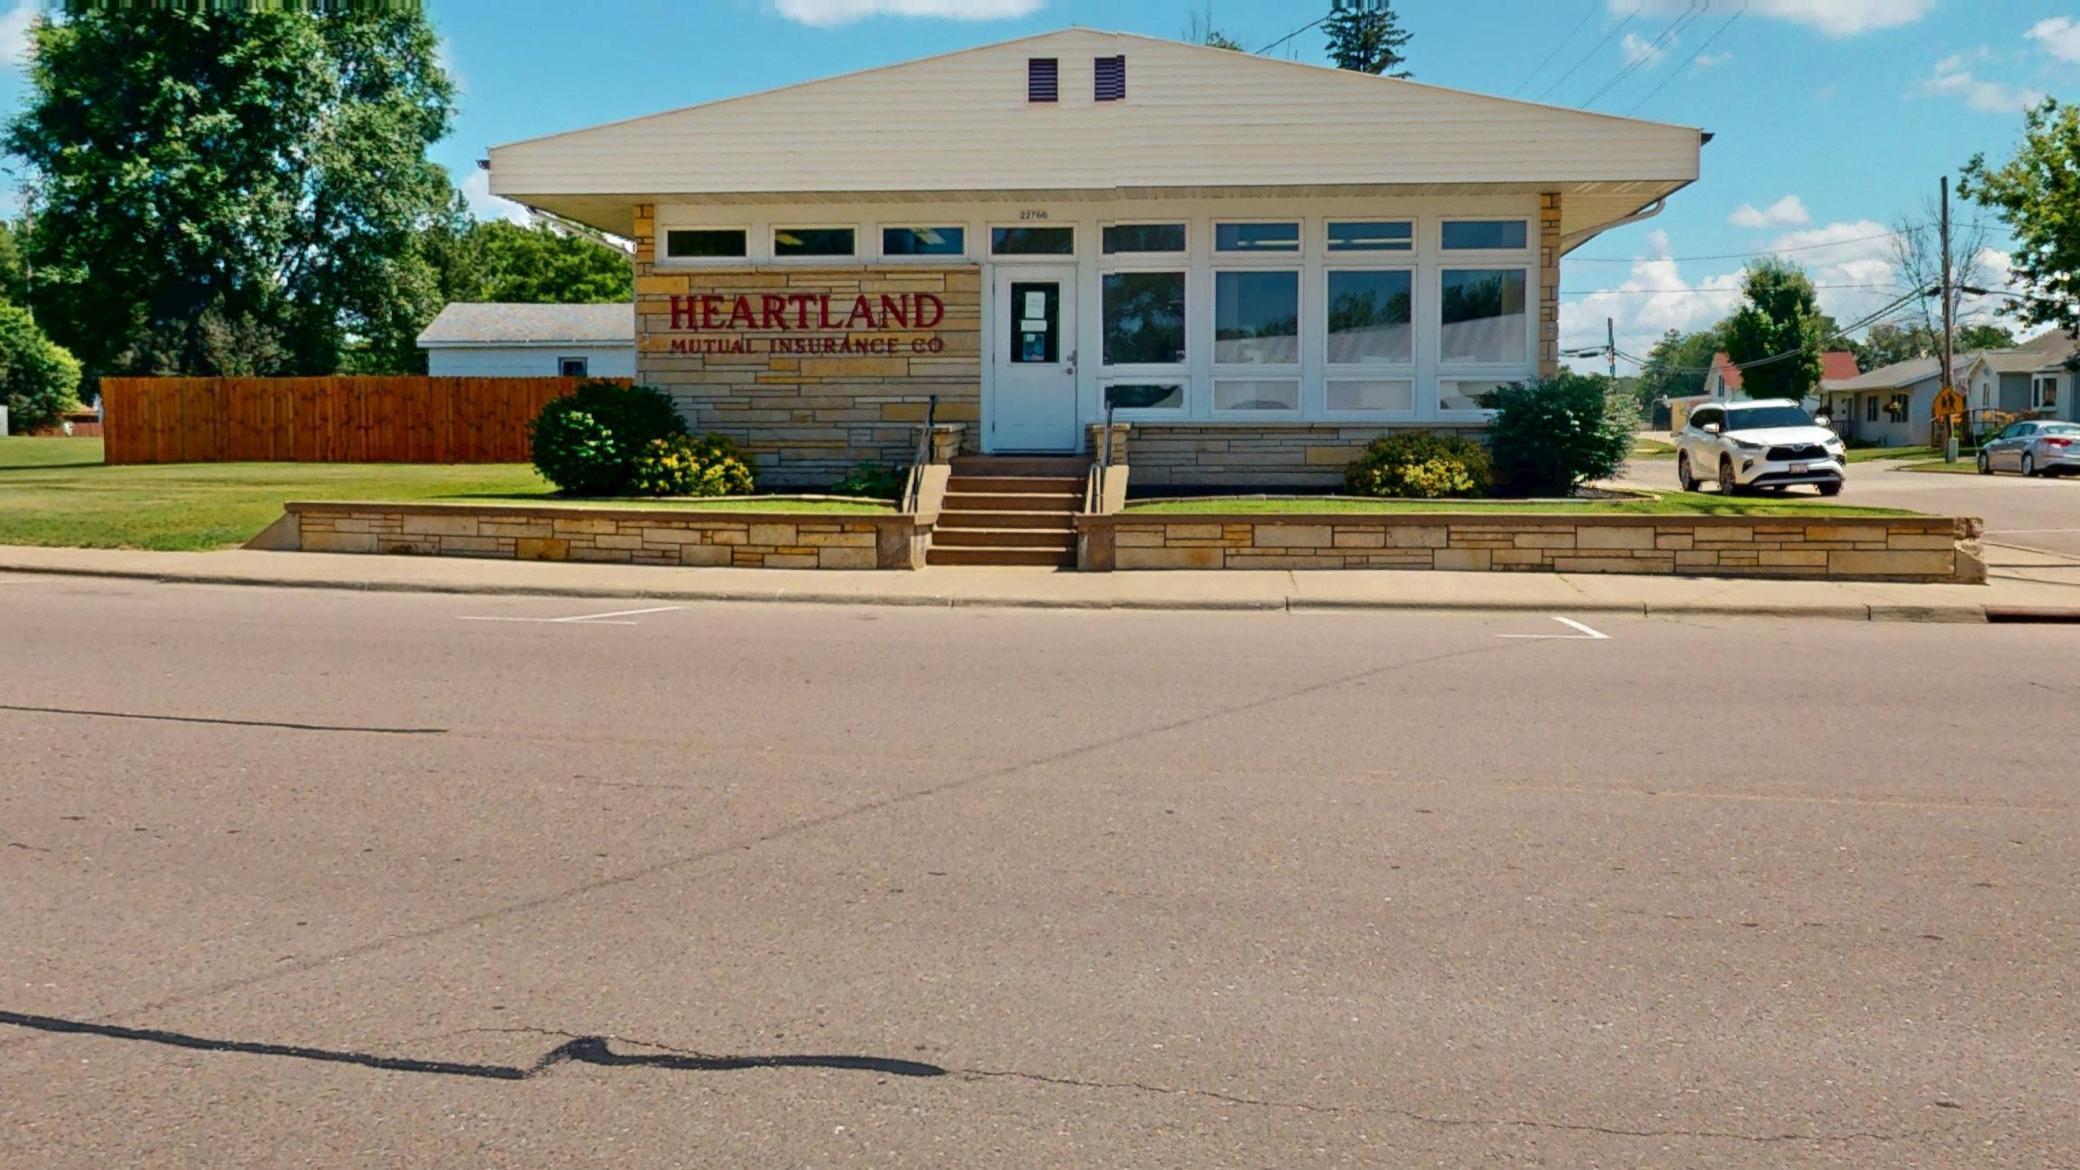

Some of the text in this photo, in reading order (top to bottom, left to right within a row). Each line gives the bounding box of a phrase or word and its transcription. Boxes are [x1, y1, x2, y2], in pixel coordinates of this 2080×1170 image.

[669, 293, 945, 330] HEARTLAND
[671, 337, 945, 354] MUTUAL INSURANCE CO
